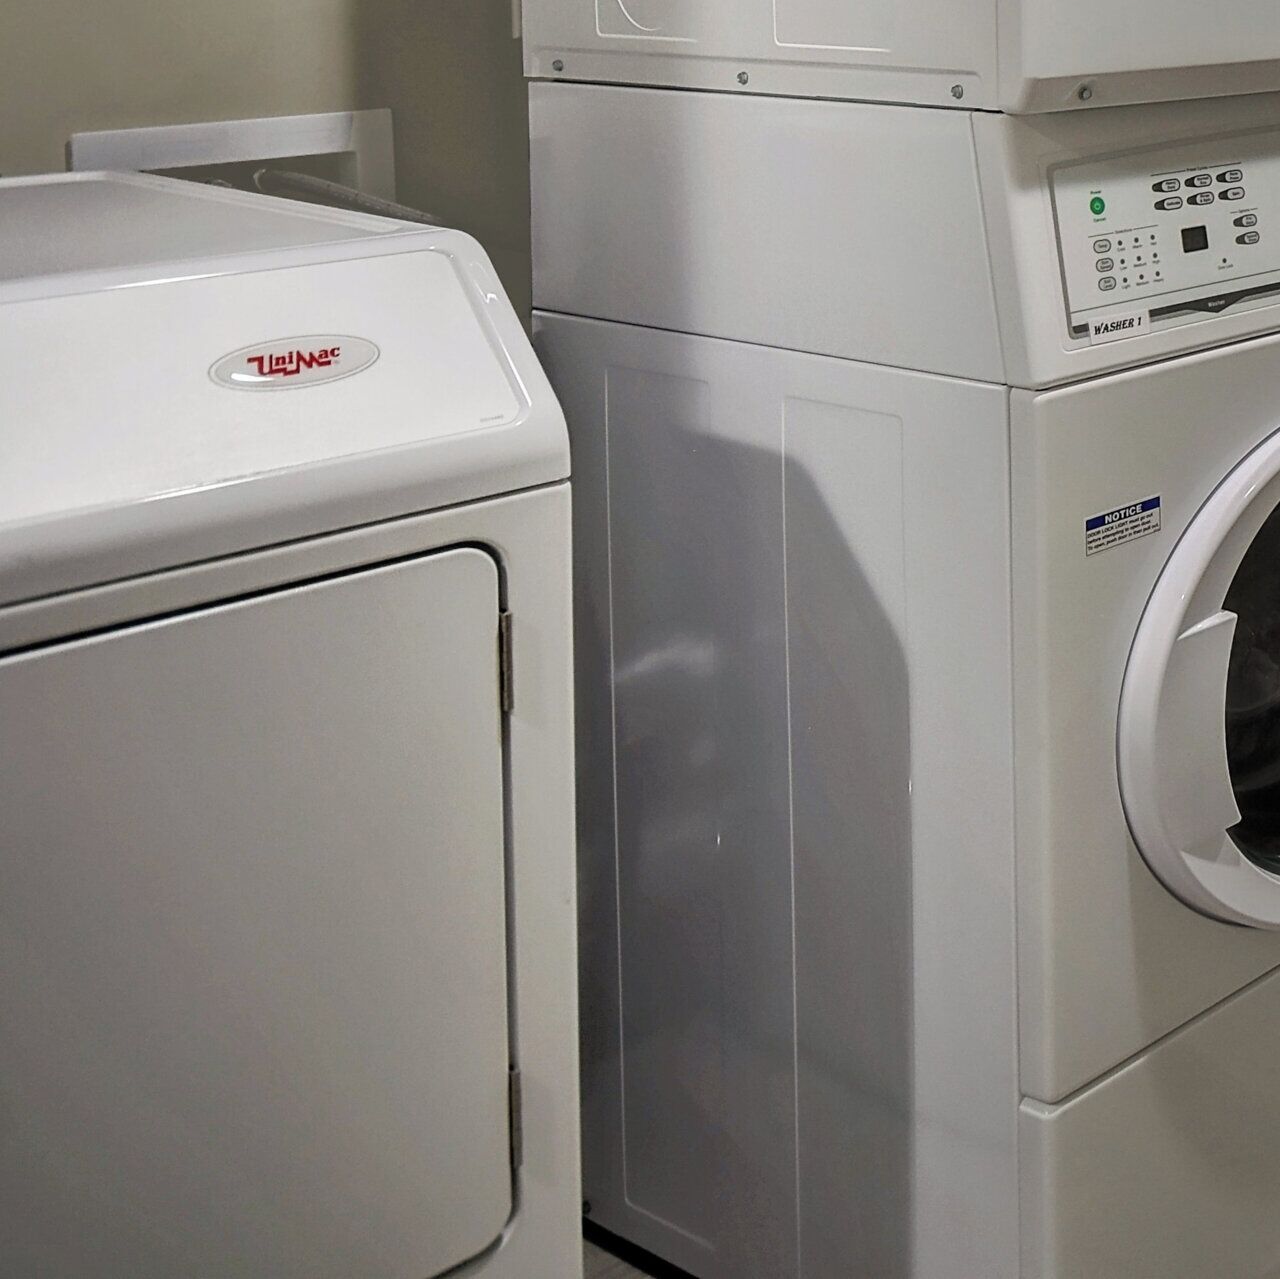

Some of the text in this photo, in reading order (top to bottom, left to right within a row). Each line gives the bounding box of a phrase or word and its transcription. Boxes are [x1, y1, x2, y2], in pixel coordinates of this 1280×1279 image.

[1094, 318, 1135, 335] WASHER
[247, 346, 341, 376] UniMac
[1104, 504, 1143, 524] NOTICE
